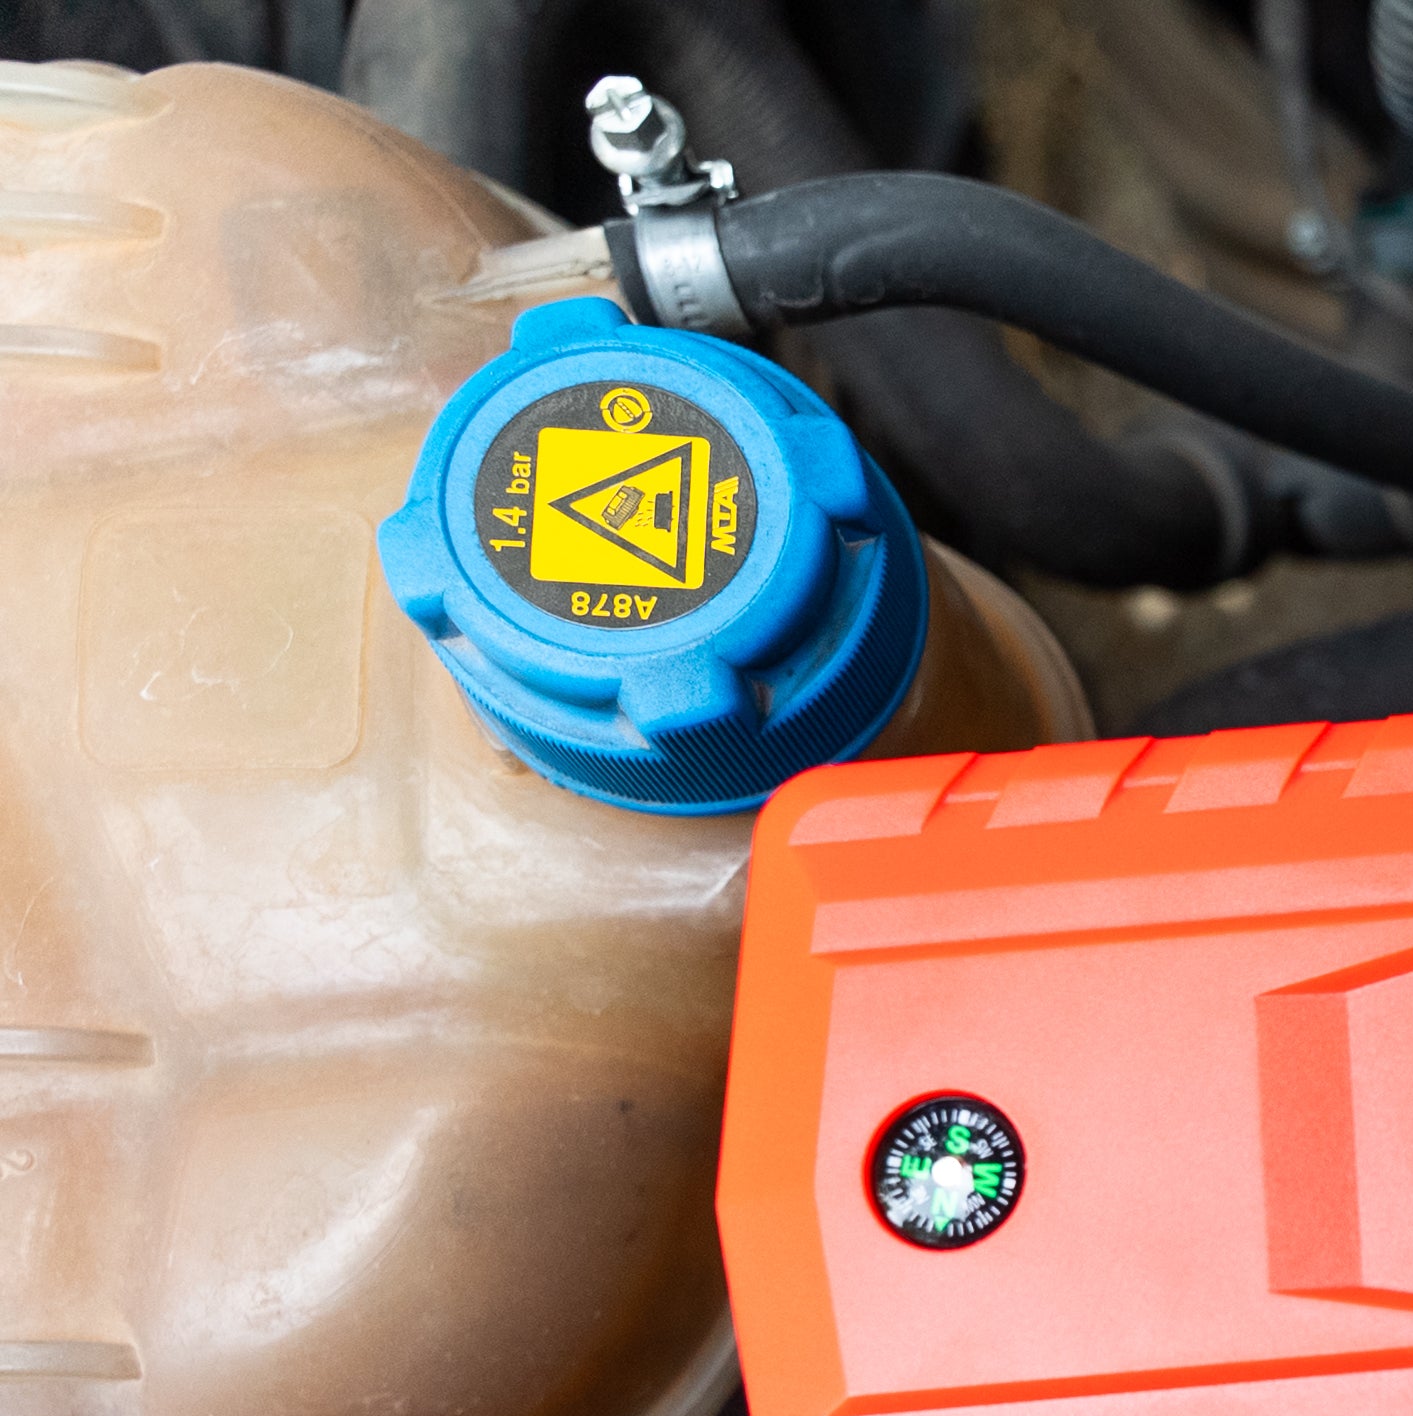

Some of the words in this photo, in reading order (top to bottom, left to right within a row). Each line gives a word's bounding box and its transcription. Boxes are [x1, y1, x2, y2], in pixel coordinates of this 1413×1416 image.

[506, 451, 532, 494] bar
[489, 505, 528, 552] 1.4
[711, 476, 739, 555] MTA
[571, 591, 658, 620] A878
